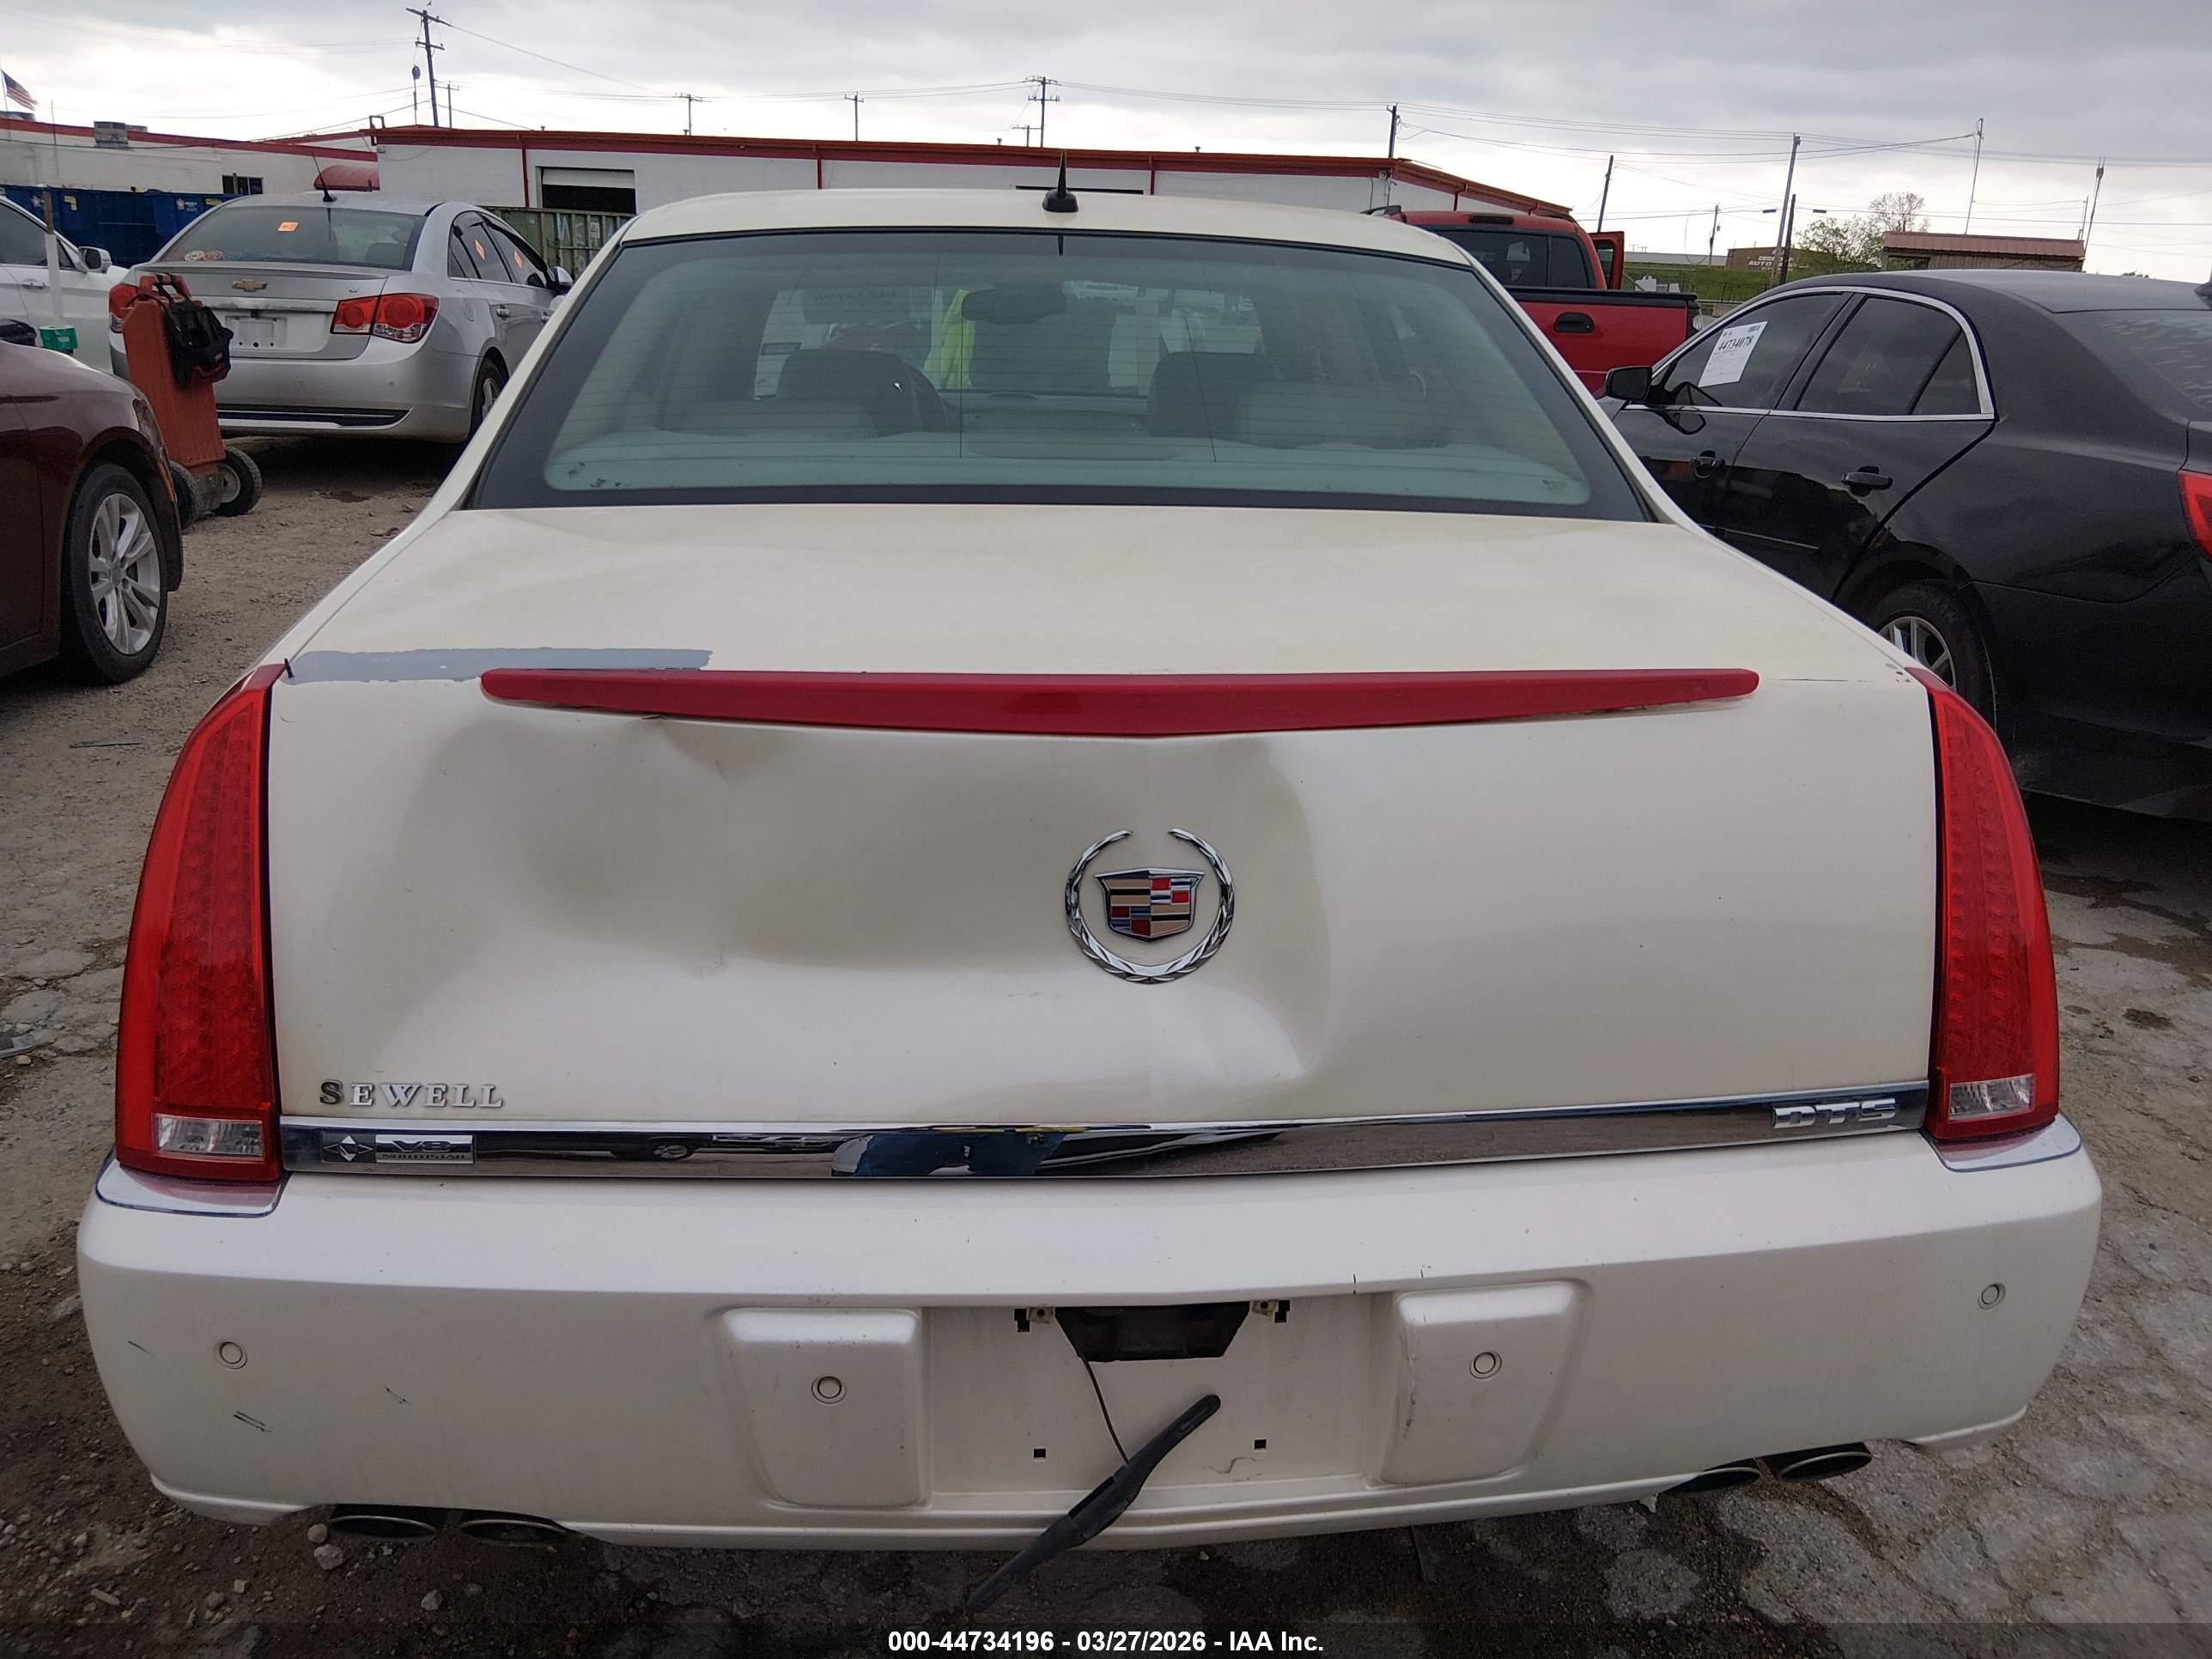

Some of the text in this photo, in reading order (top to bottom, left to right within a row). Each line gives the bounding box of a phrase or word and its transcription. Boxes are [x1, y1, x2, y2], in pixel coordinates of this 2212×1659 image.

[319, 1080, 503, 1109] SEWELL
[1772, 1097, 1896, 1129] DTS
[392, 1139, 453, 1153] V8
